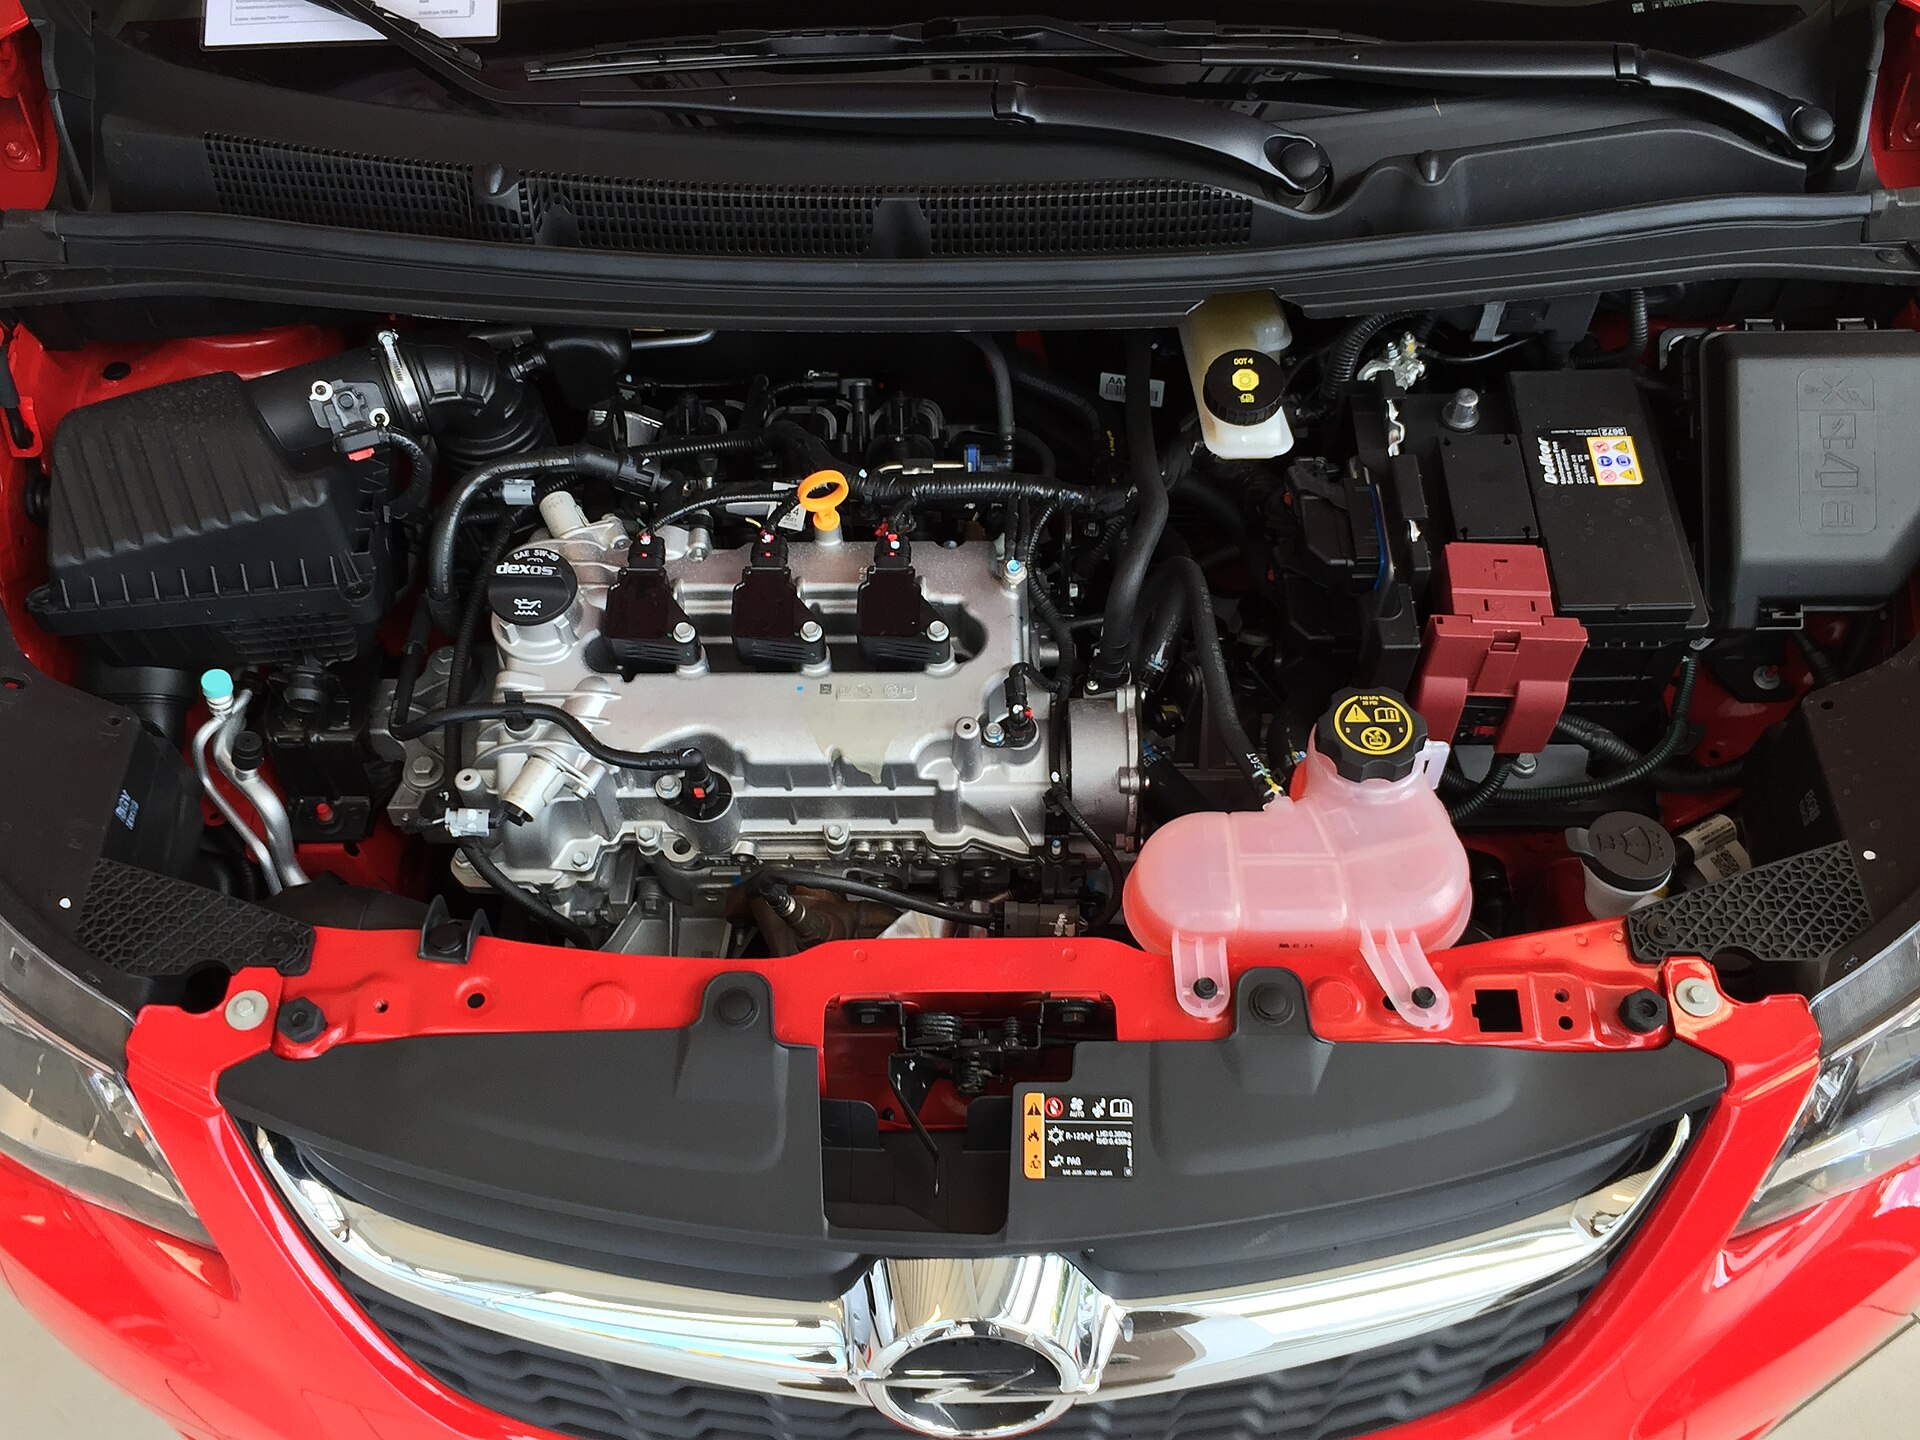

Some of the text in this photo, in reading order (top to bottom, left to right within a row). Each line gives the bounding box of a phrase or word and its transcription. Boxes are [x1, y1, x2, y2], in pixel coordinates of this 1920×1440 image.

[1233, 357, 1254, 365] DOT 4
[1538, 436, 1558, 485] Delkor
[513, 550, 530, 560] SAE
[496, 562, 557, 576] dexos
